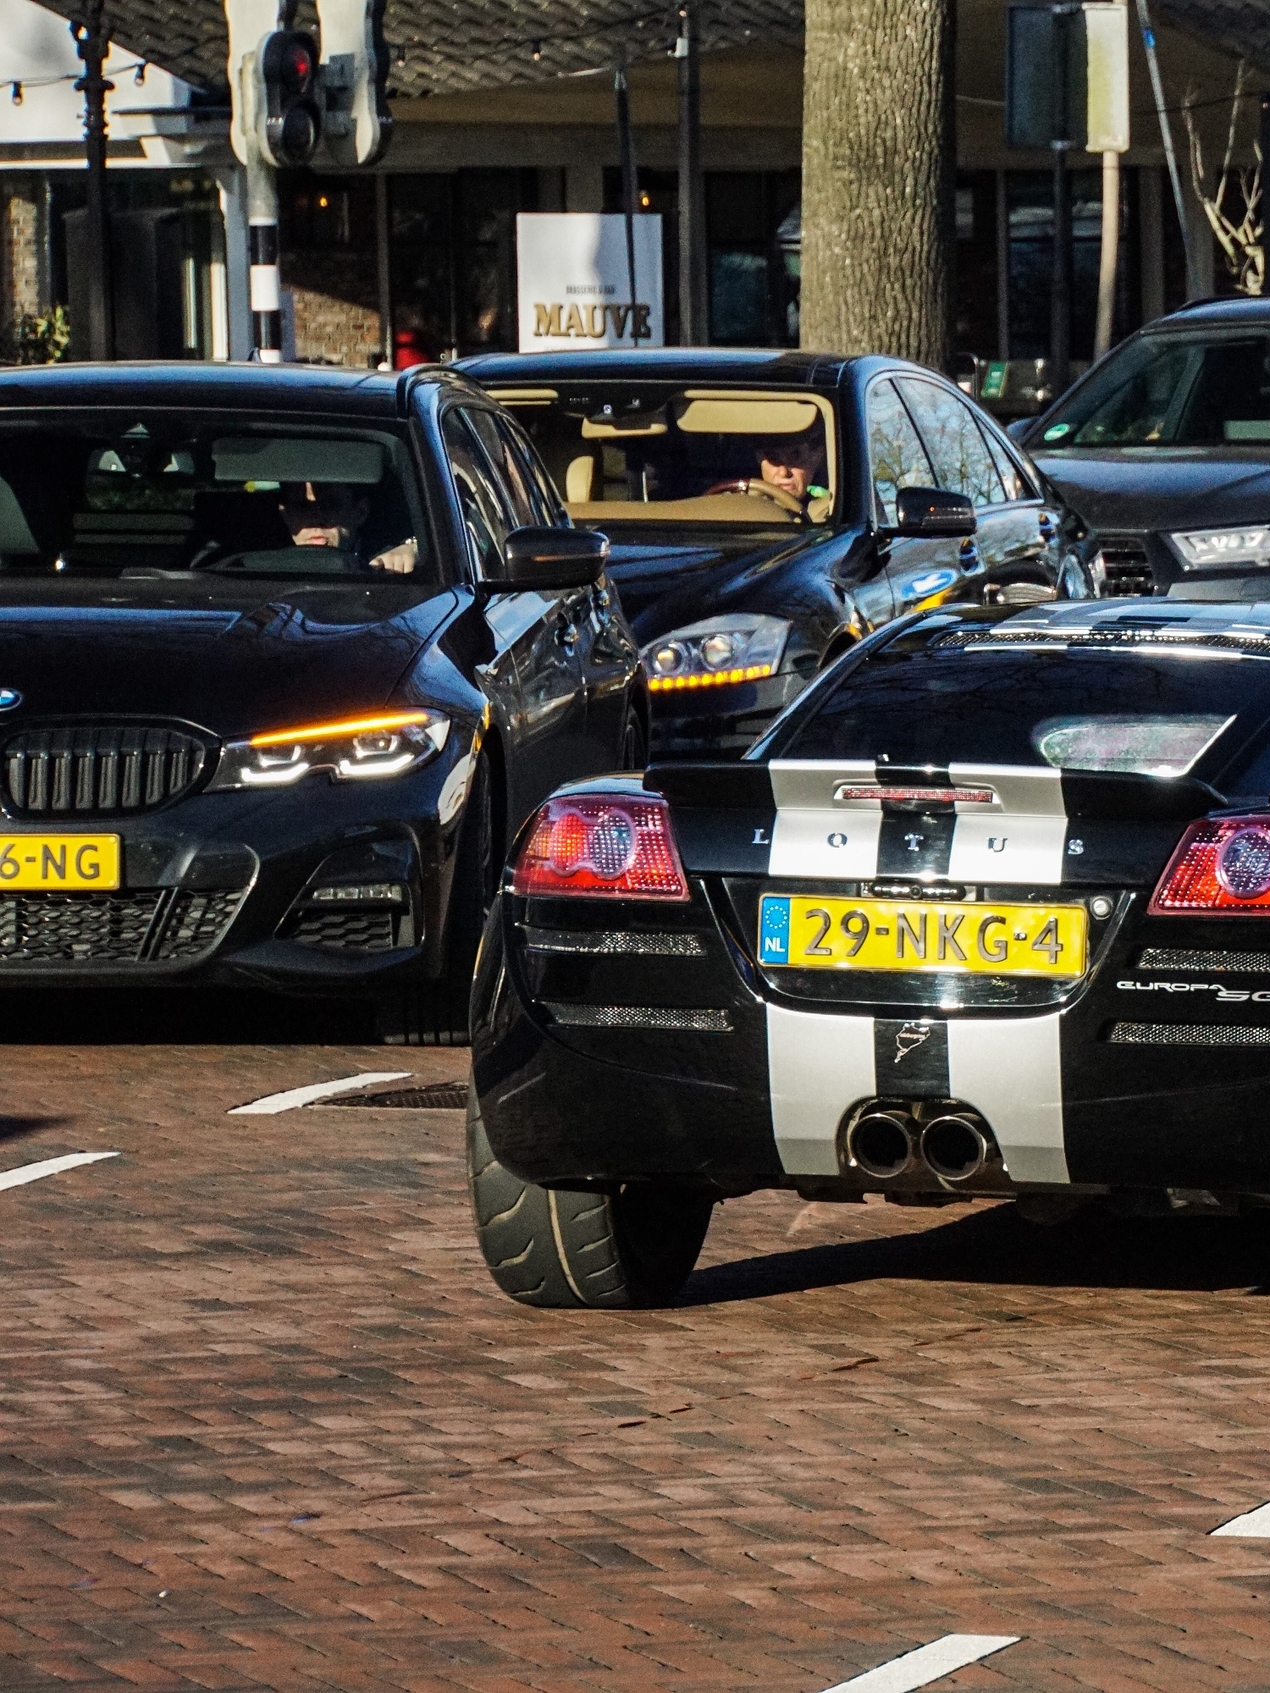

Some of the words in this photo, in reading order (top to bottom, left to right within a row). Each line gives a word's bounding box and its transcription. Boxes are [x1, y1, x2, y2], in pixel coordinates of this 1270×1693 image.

[533, 303, 651, 338] MAUVE
[752, 828, 1085, 855] LOTUS
[765, 936, 785, 952] NL
[804, 909, 1063, 964] 29-NKG-4
[1116, 981, 1227, 993] EUROPA
